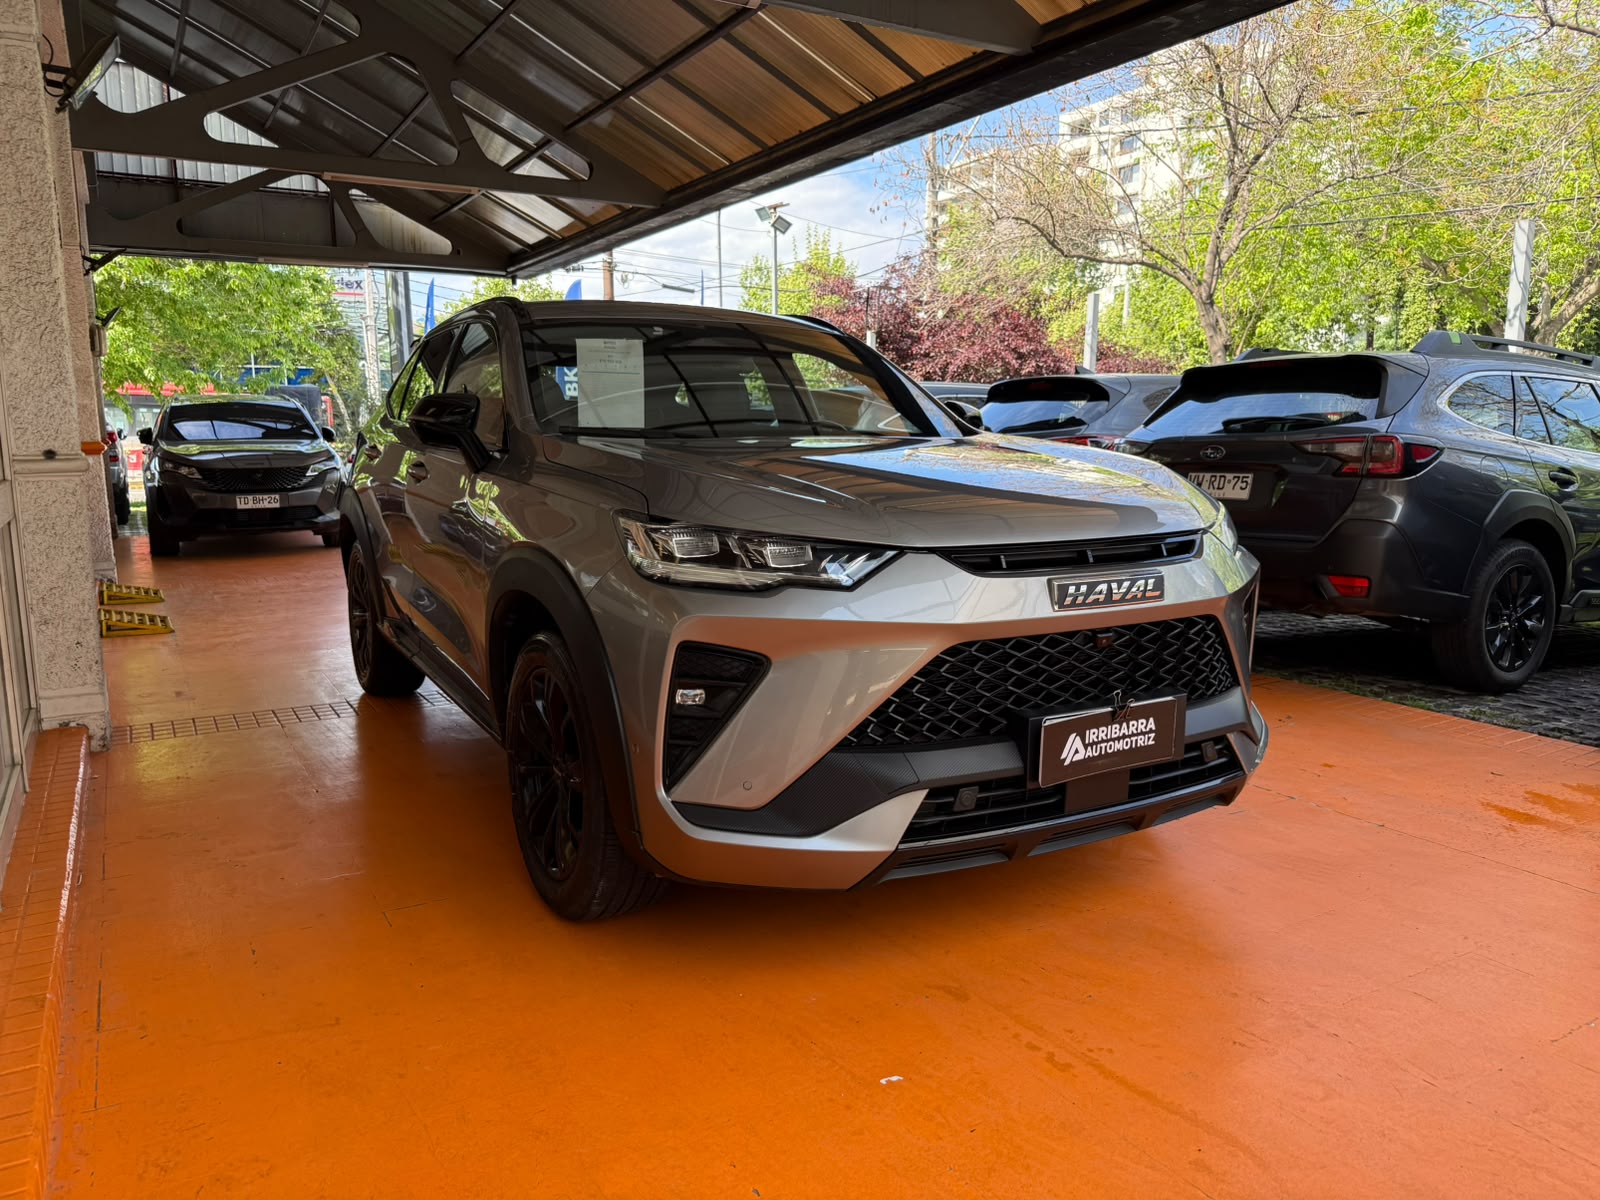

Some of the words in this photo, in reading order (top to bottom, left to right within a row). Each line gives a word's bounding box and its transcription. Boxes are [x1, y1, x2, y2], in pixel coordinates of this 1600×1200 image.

[1063, 578, 1162, 606] HAVAL
[1085, 716, 1156, 744] IRRIBARRA
[1084, 732, 1156, 759] AUTOMOTRIZ
